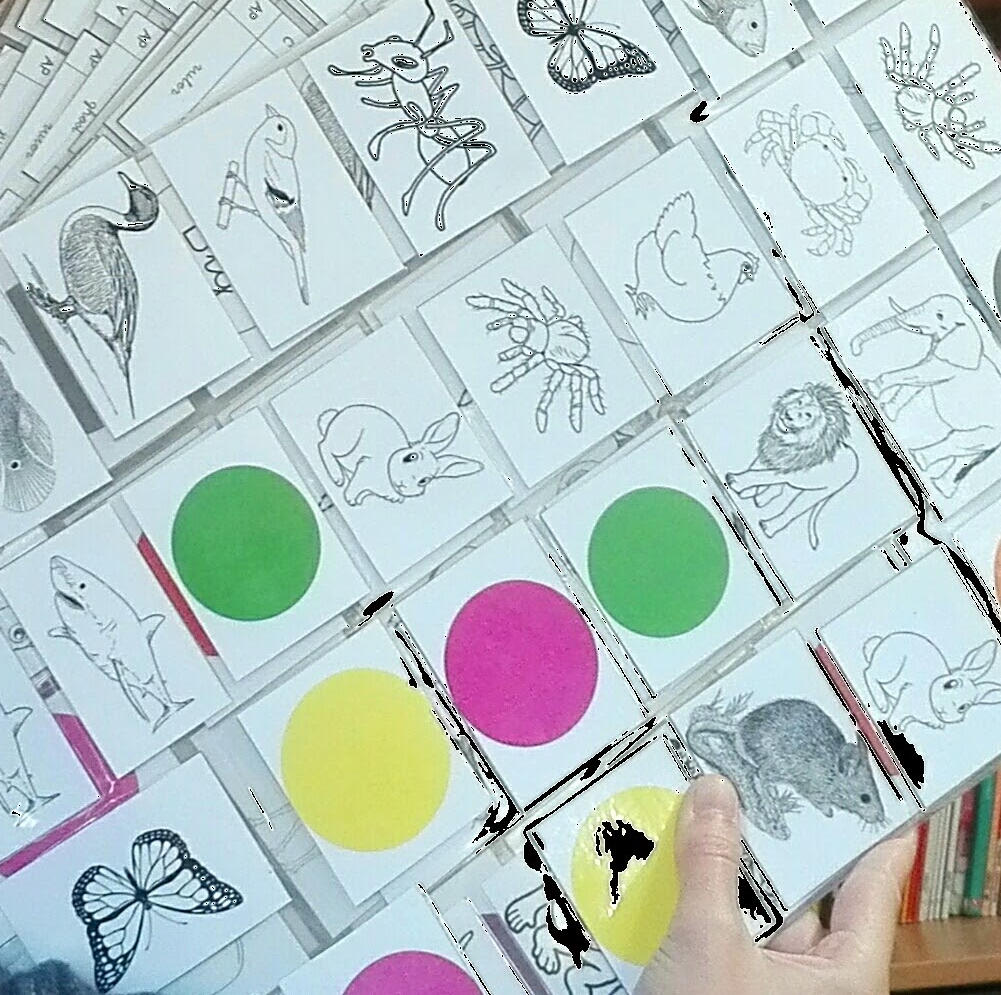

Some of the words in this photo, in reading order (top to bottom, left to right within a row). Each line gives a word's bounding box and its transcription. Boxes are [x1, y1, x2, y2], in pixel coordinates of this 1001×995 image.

[248, 0, 264, 21] AP
[138, 28, 152, 49] AP
[282, 35, 295, 48] C
[39, 55, 54, 77] AP
[170, 63, 203, 97] ruler
